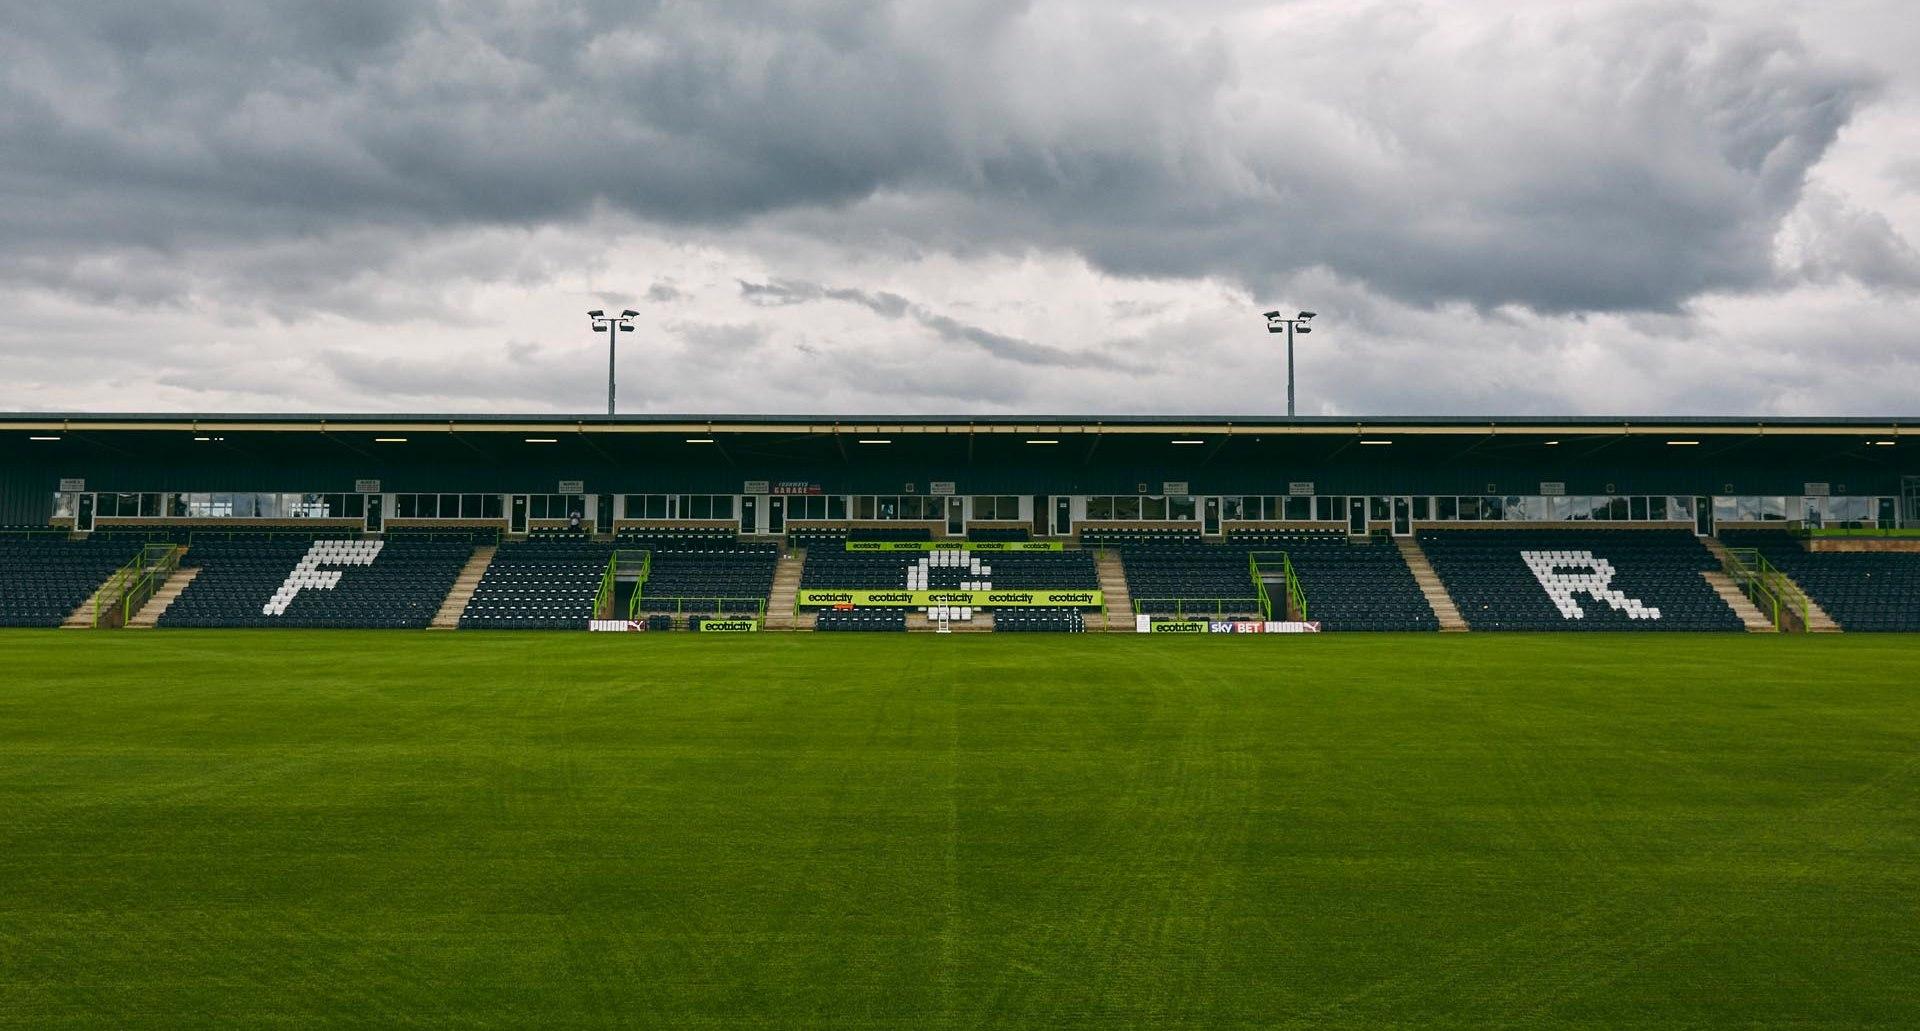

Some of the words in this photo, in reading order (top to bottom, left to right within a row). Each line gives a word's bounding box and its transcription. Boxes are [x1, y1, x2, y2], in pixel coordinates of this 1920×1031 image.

[774, 487, 808, 495] GARAGE
[263, 540, 384, 616] F
[1520, 551, 1661, 619] R
[808, 593, 853, 604] ecotricity
[868, 593, 913, 604] ecotricity
[928, 593, 973, 604] ecotricity
[988, 593, 1033, 604] ecotricity
[1048, 593, 1093, 604] ecotricity
[590, 620, 628, 631] PUMA
[705, 621, 752, 631] ecotricity
[1156, 622, 1203, 632] ecotricity
[1237, 622, 1259, 632] BET
